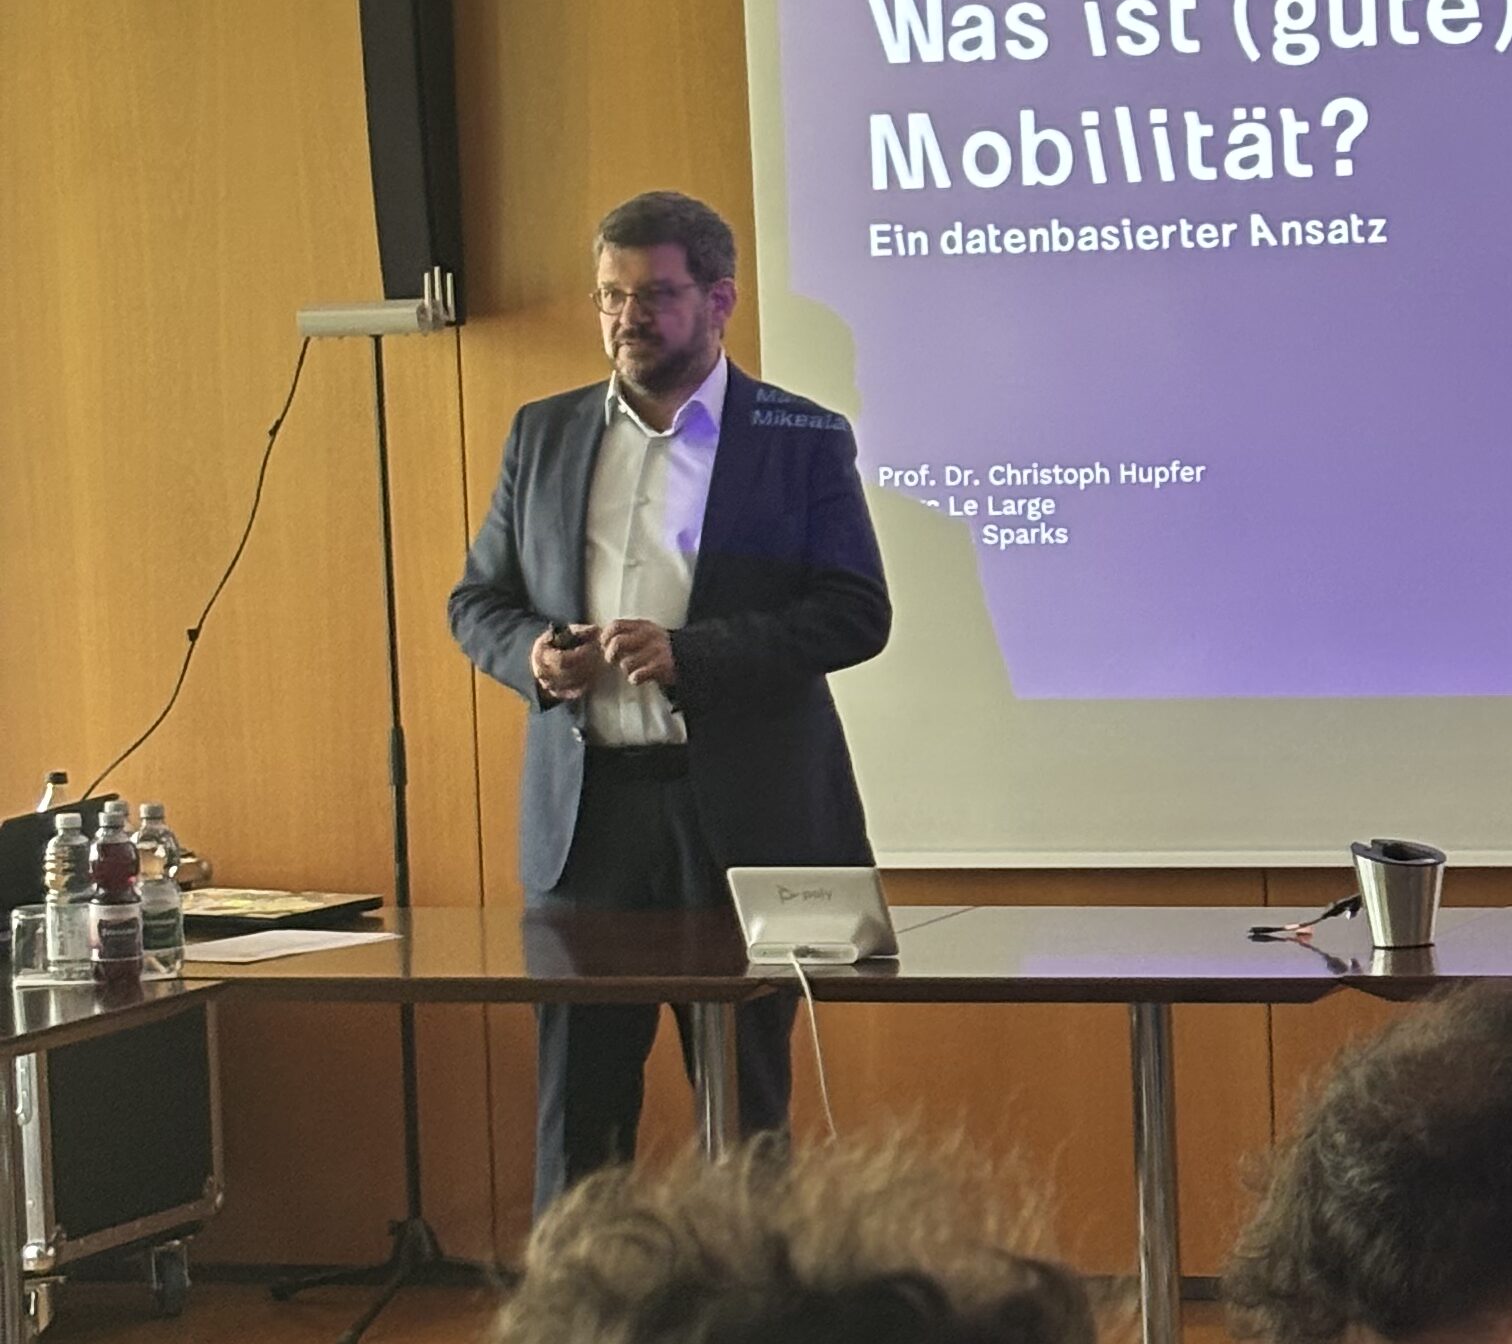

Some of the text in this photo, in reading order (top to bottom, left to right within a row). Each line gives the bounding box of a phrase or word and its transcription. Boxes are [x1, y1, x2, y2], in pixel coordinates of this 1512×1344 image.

[869, 97, 1369, 191] Mobilität?
[869, 213, 1388, 257] Ein datenbasierter Ansatz
[878, 460, 1206, 490] Prof. Dr. Christoph Hupfer
[948, 495, 979, 516] Le
[987, 495, 1056, 521] Large
[982, 522, 1069, 551] Sparks
